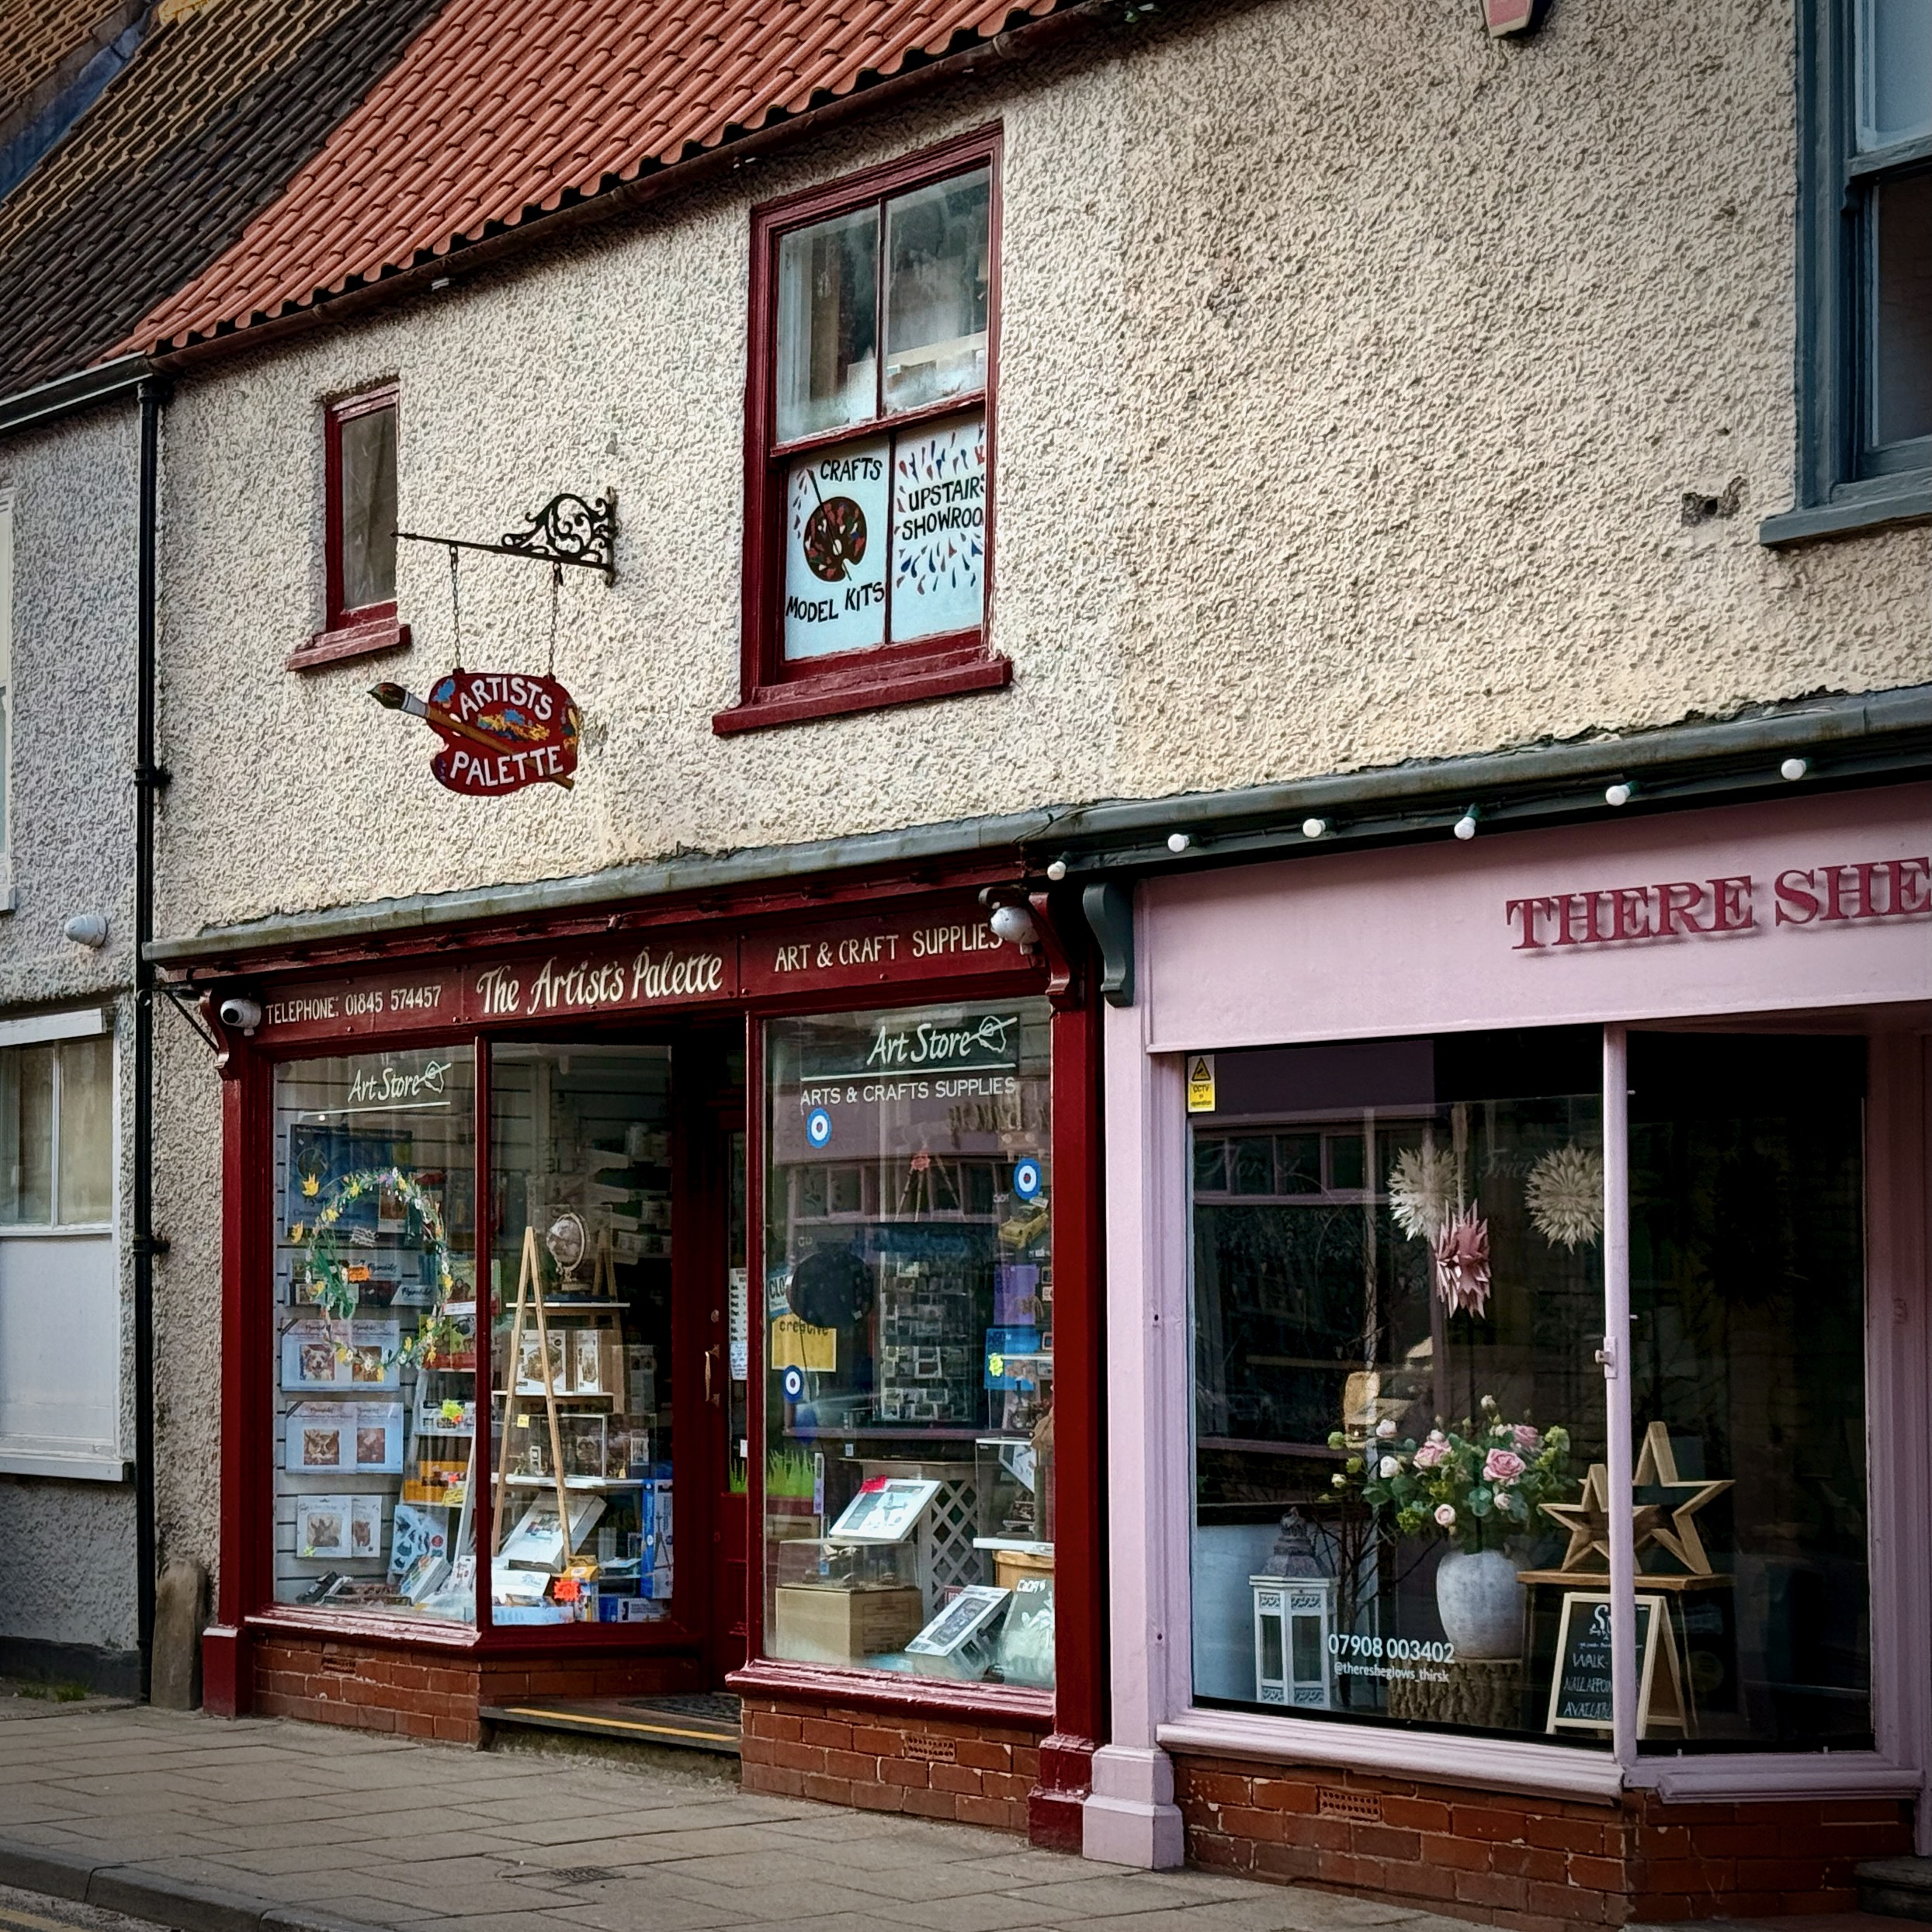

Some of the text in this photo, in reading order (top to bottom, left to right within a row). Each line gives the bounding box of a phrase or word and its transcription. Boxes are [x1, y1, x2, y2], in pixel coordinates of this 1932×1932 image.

[820, 457, 883, 482] CRAFTS
[901, 507, 984, 541] SHOWROO
[786, 581, 885, 622] MODEL KITS
[458, 676, 553, 721] ARTISTS
[449, 744, 564, 787] PALETTE
[1506, 856, 1932, 950] THERE SHE
[774, 943, 811, 973] ART
[817, 942, 834, 968] &
[838, 934, 900, 966] CRAFT
[476, 945, 723, 1015] The Artist's Palette
[345, 990, 383, 1016] 01845
[390, 985, 442, 1011] 574457
[866, 1022, 972, 1067] Art Store
[348, 1067, 421, 1103] Art Store
[800, 1076, 1017, 1108] ARTS & CRAFTS SUPPLIES
[1328, 1633, 1456, 1664] 07908 003402
